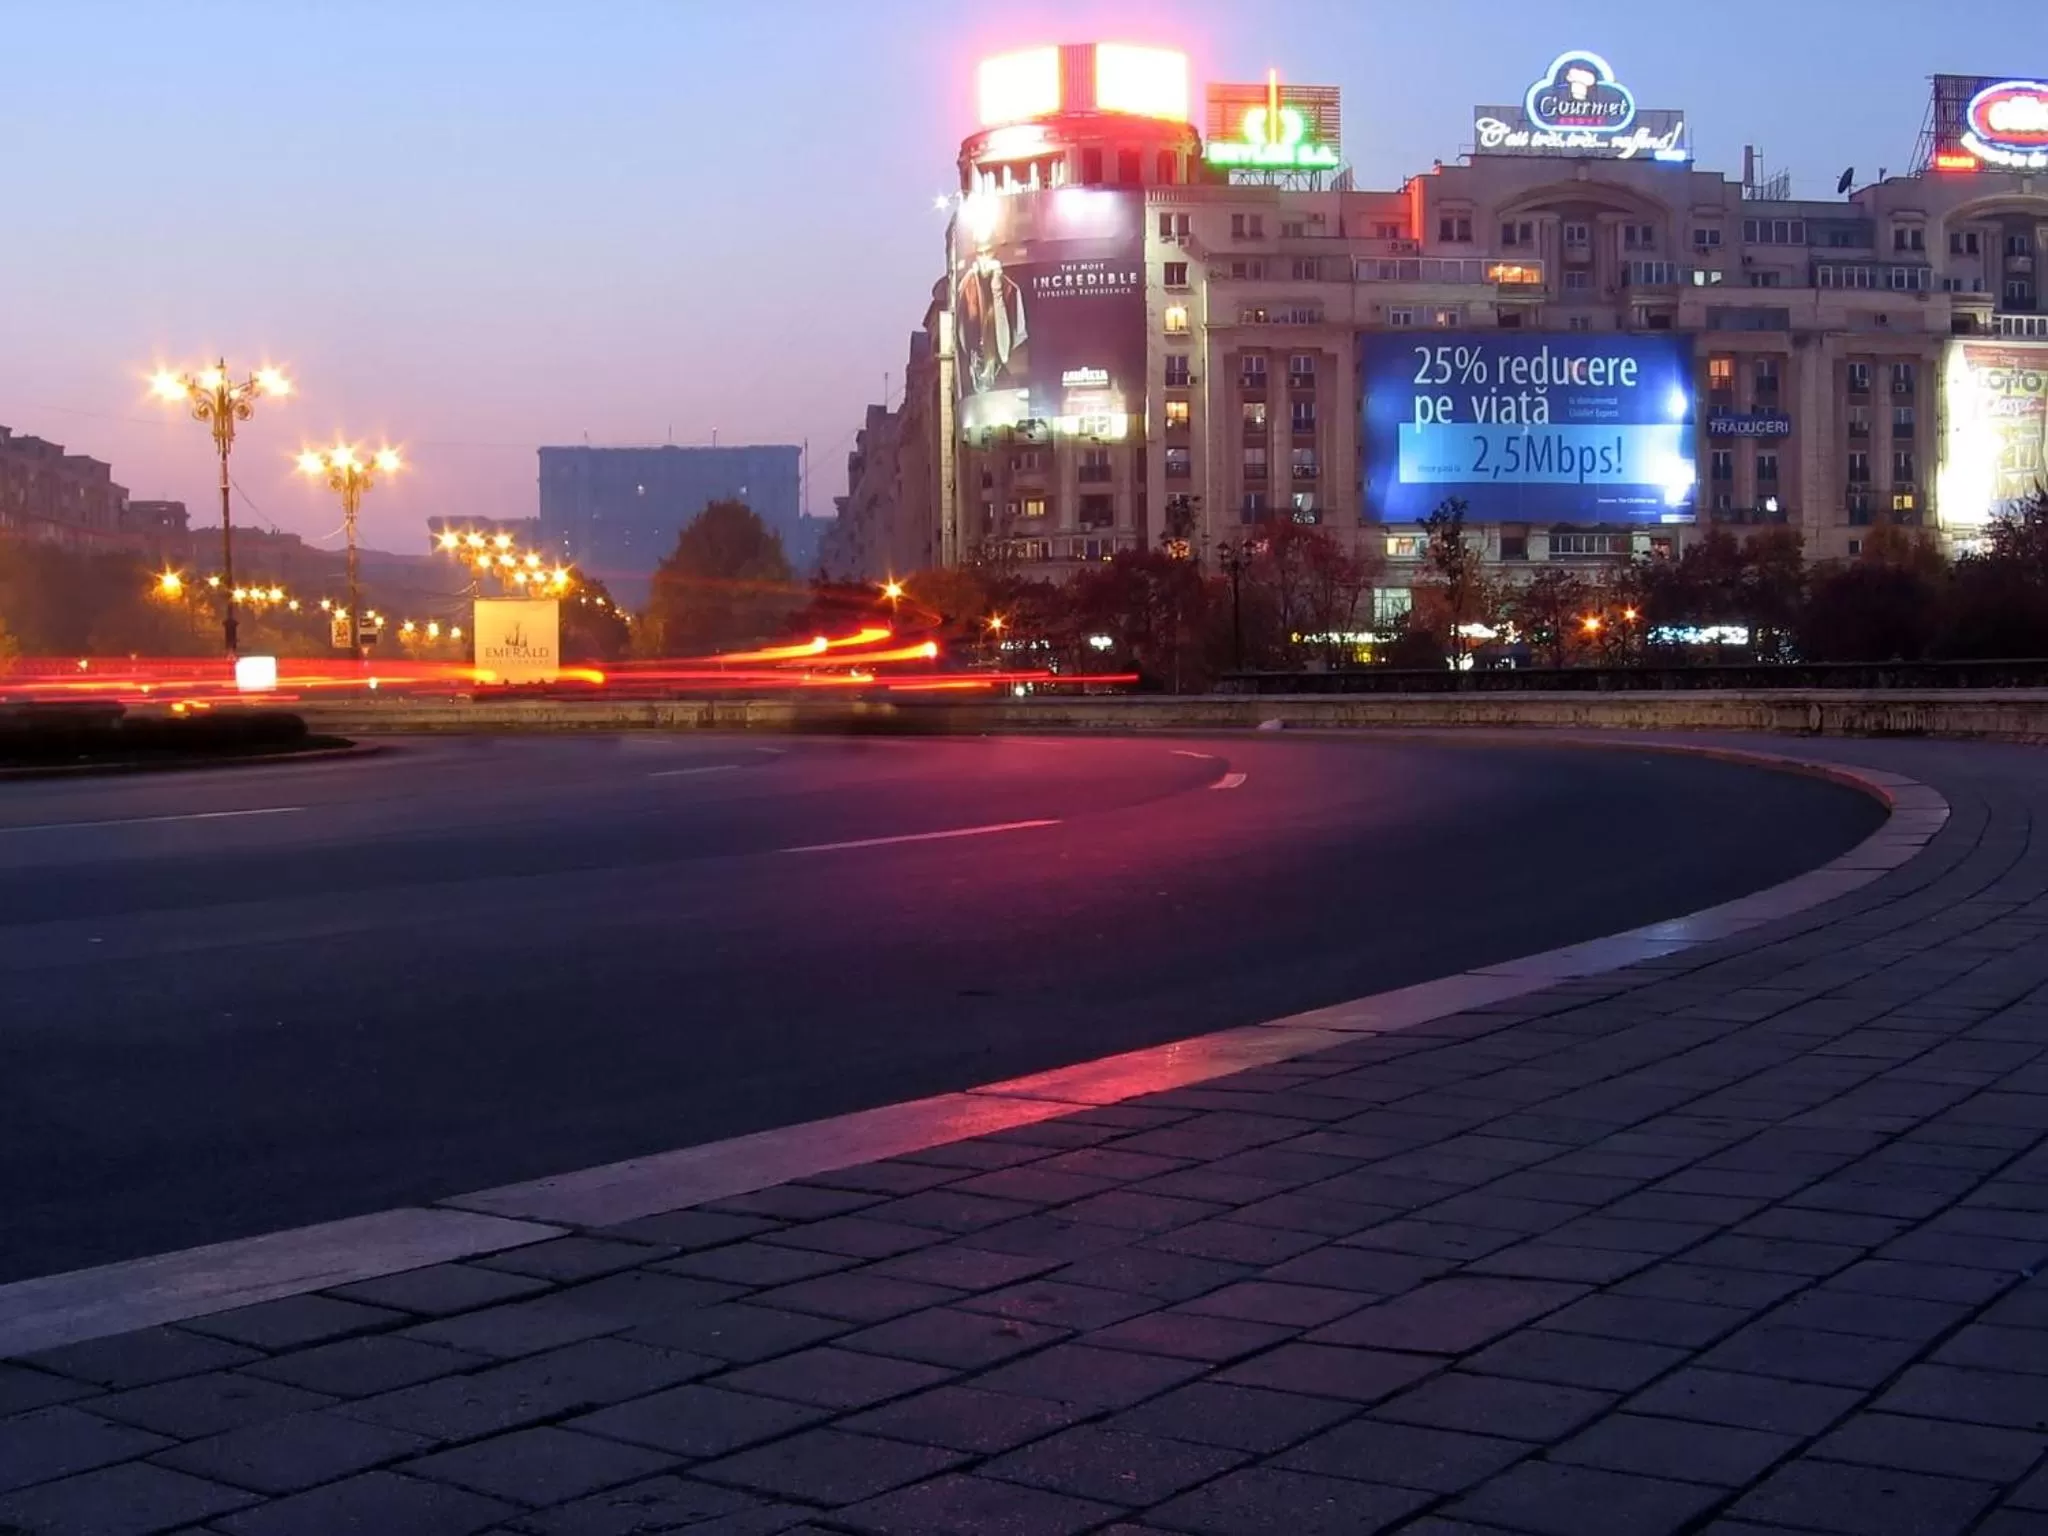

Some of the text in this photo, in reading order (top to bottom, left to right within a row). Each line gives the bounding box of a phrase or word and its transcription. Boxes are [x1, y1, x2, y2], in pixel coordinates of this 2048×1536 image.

[1540, 96, 1628, 117] Gourmet
[1033, 273, 1137, 288] INCREDIBLE
[1413, 345, 1638, 386] 25% reducere
[1415, 392, 1454, 434] pe
[1709, 420, 1789, 434] TRADUCERI
[1472, 434, 1623, 483] 2,5Mbps!
[485, 647, 549, 658] EMERALD
